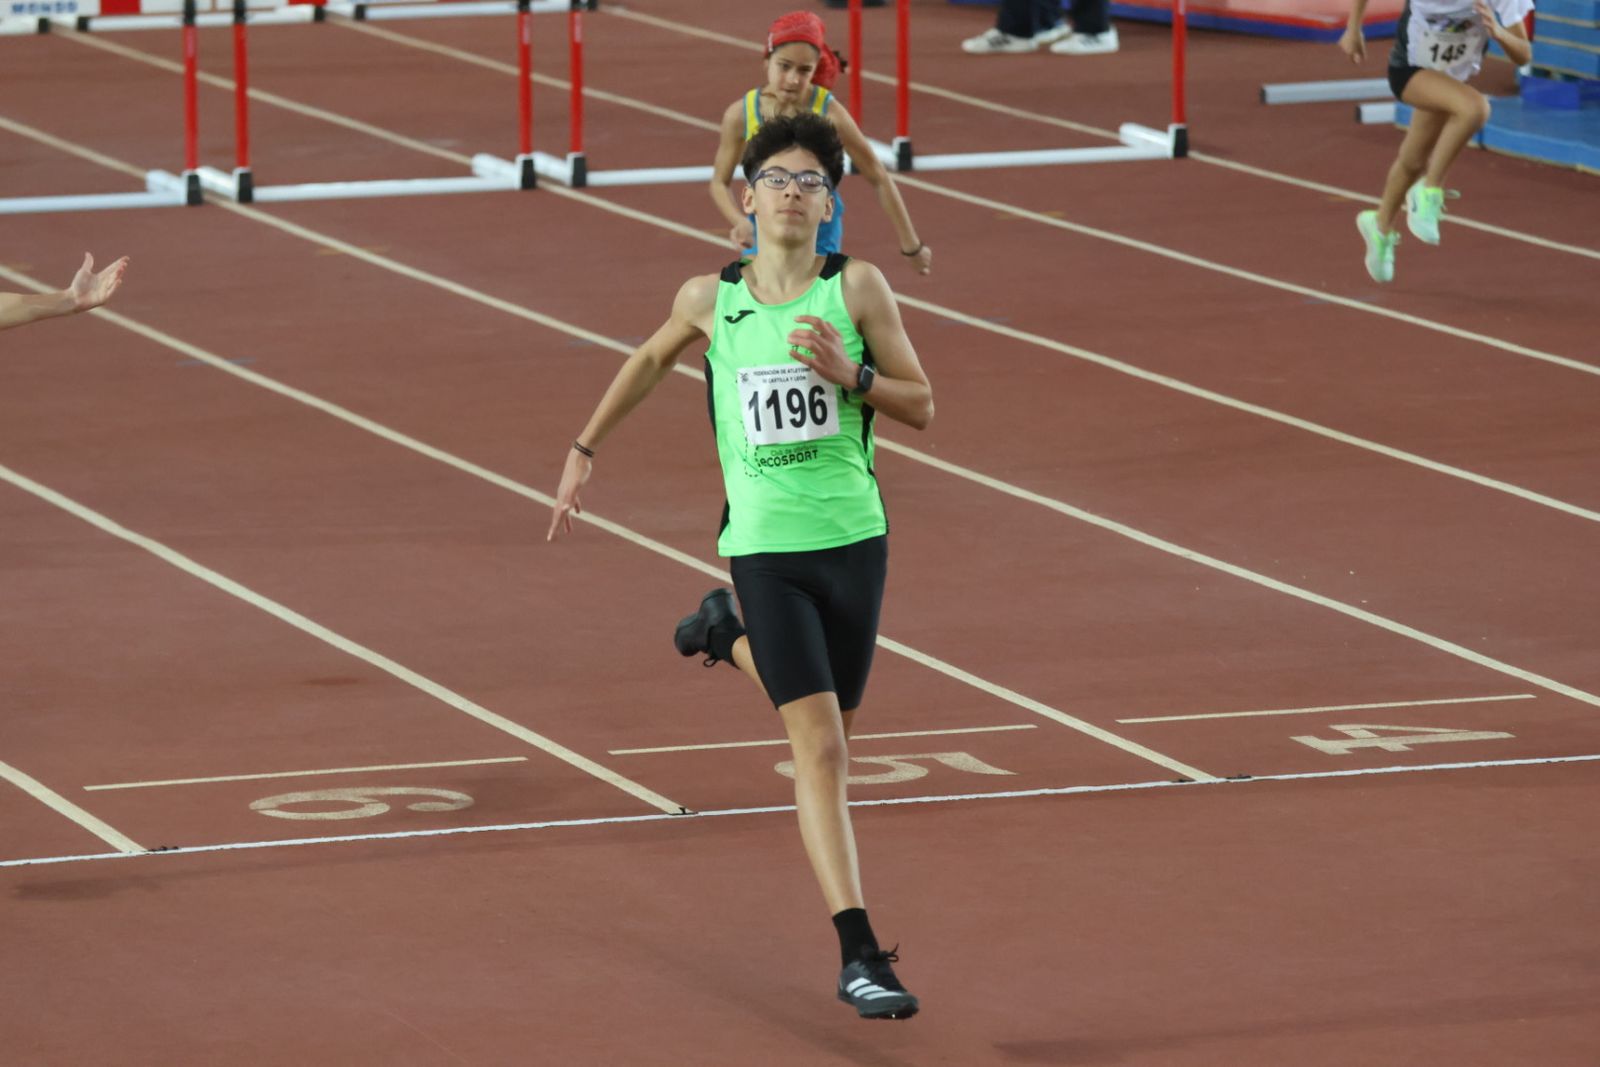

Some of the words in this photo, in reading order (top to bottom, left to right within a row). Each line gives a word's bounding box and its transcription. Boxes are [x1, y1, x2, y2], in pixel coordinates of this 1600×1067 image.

[748, 385, 828, 432] 1196
[1289, 723, 1516, 755] 4
[774, 751, 1018, 785] 5
[249, 786, 475, 820] 6
